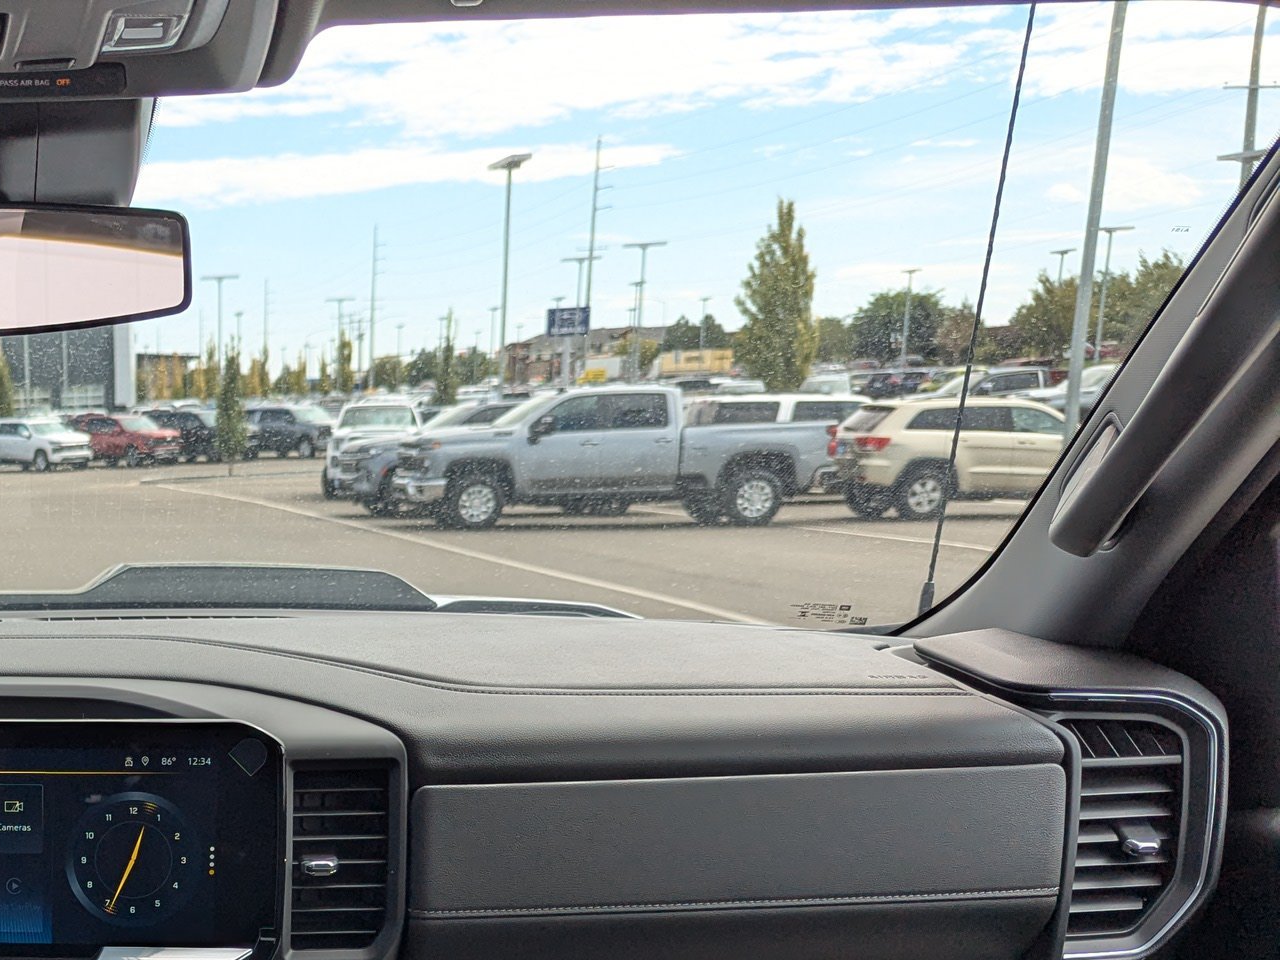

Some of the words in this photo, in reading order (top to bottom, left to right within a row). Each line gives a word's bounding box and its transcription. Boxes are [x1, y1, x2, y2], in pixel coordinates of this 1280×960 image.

[0, 80, 18, 88] PASS
[161, 757, 176, 766] 86°
[188, 758, 211, 766] 12:34
